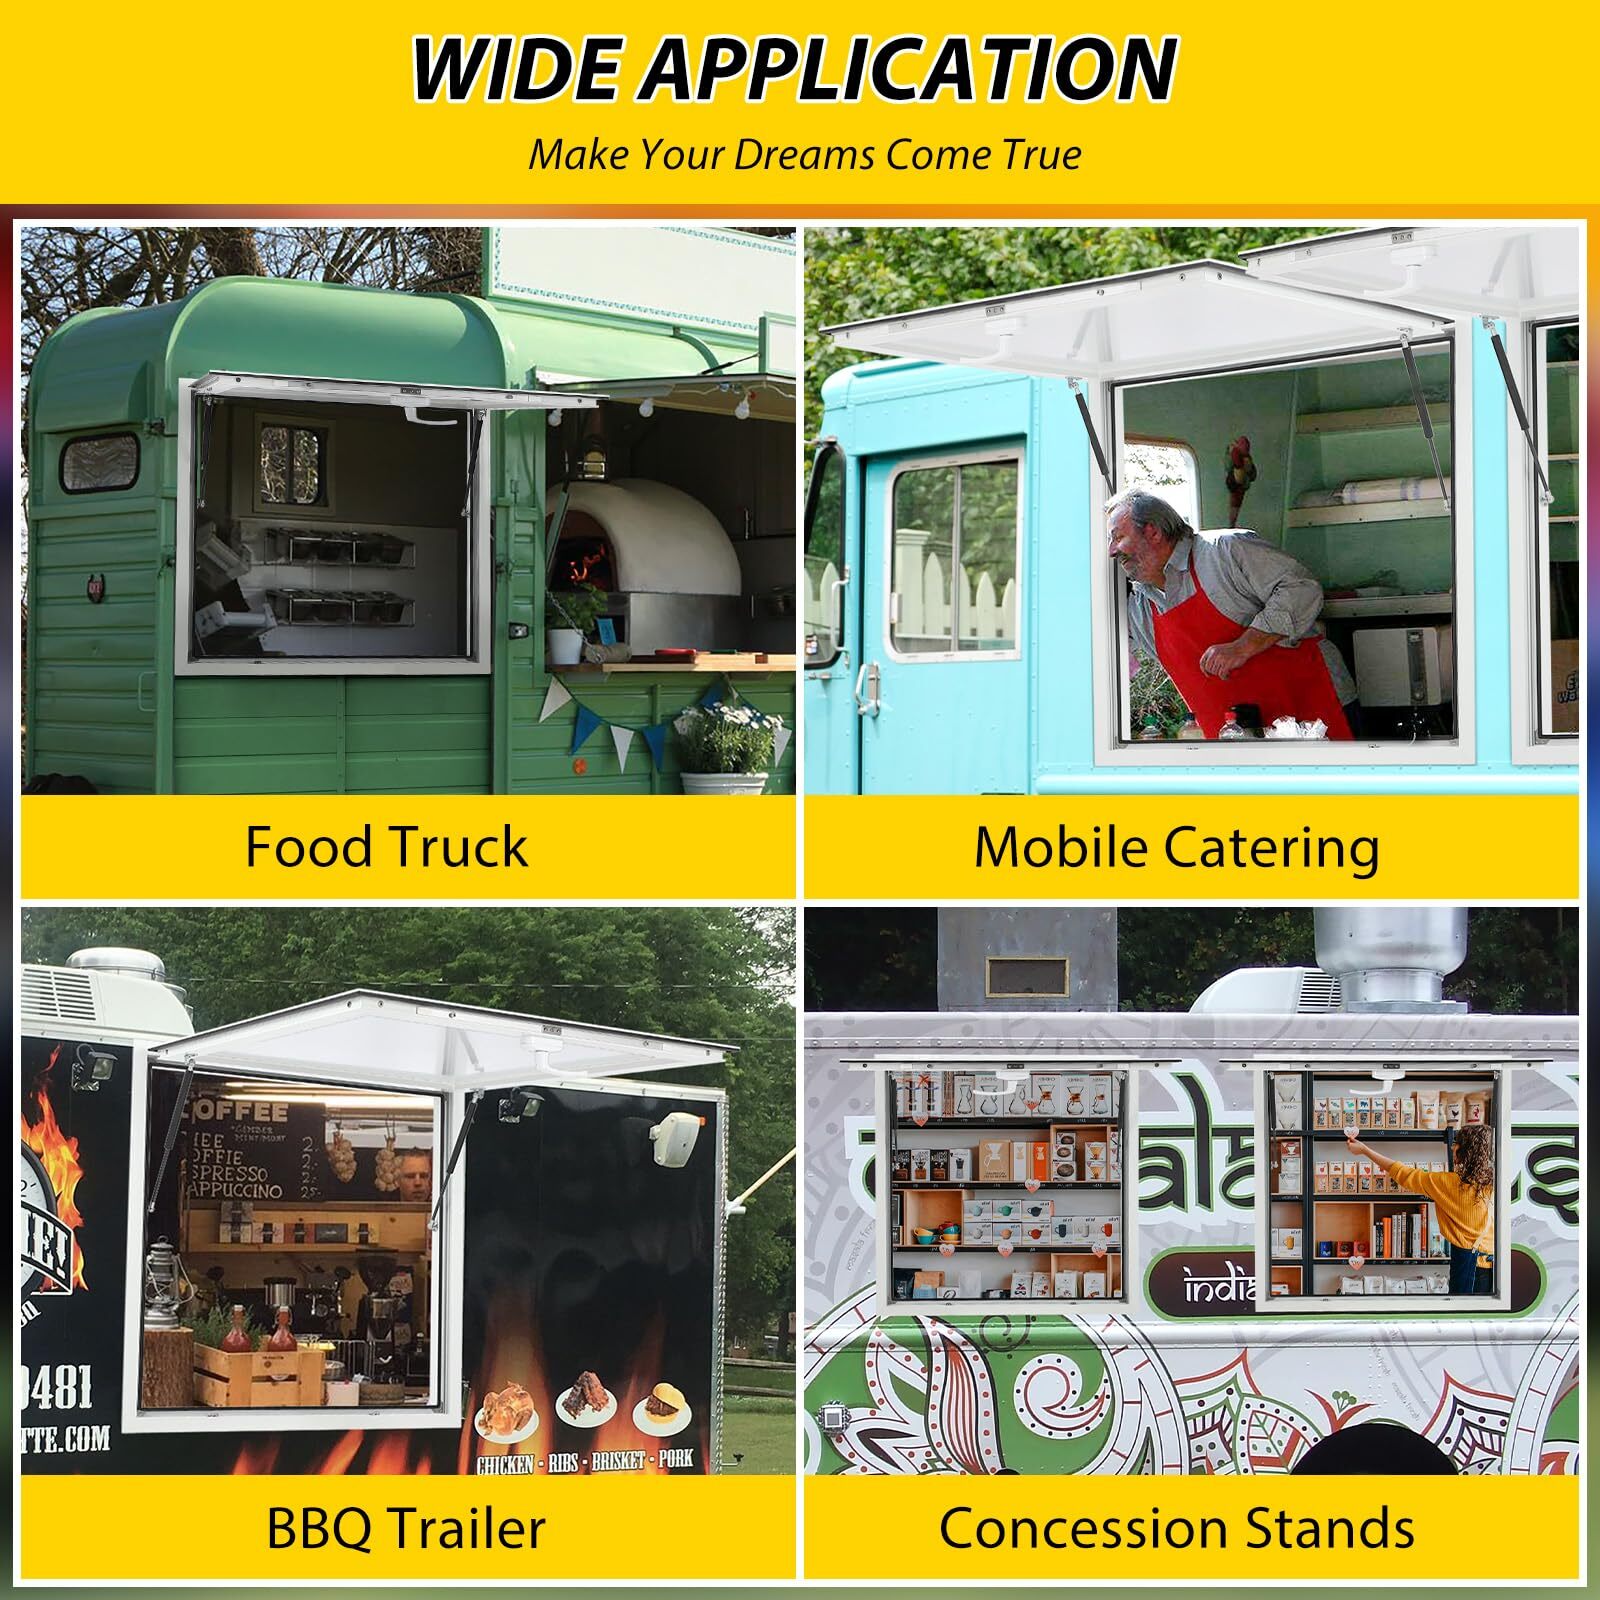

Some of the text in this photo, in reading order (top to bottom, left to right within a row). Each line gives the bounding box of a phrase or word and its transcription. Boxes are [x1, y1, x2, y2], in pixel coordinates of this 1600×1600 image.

[182, 1098, 289, 1121] OFFEE
[193, 1148, 244, 1165] OFFIE
[192, 1165, 268, 1182] SPRESSO
[189, 1181, 283, 1199] APPUCCINO
[476, 1448, 695, 1475] CHICKEN RIBS BRISKET PORK
